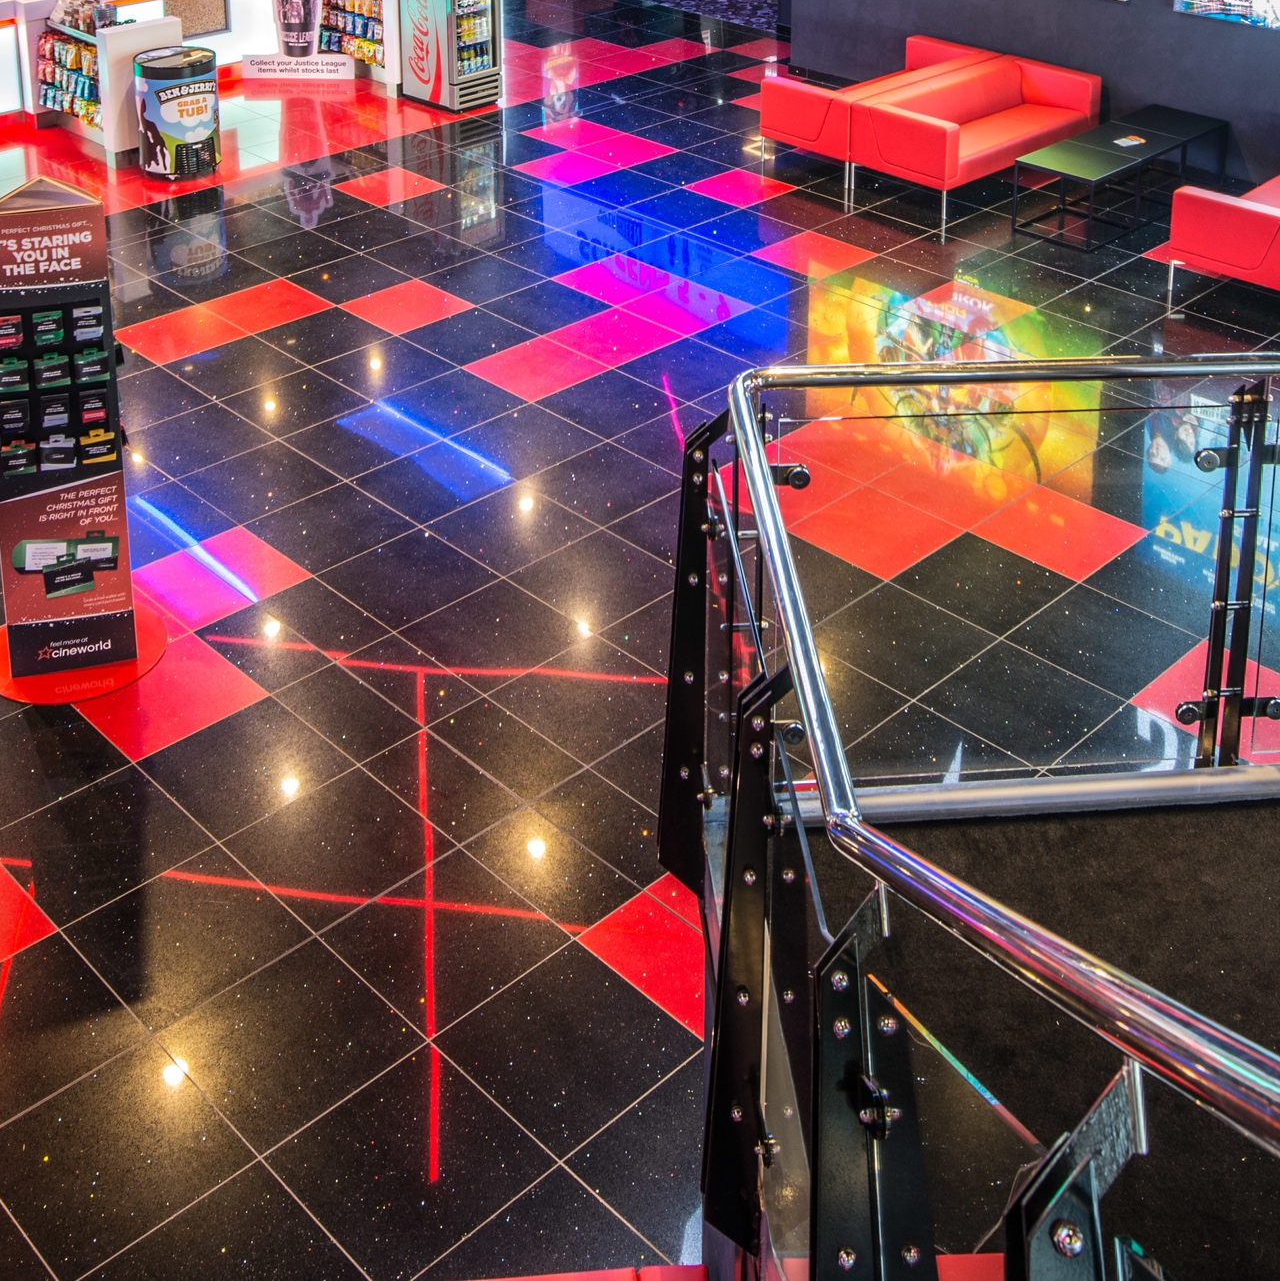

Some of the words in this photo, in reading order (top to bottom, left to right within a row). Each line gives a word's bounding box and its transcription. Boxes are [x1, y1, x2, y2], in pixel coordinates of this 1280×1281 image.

[249, 59, 275, 67] Collect
[293, 59, 319, 67] Justice
[320, 59, 347, 69] League
[158, 87, 181, 102] BEN
[180, 85, 190, 95] &
[177, 98, 201, 108] GRAB
[201, 96, 207, 104] A
[177, 104, 208, 119] TUB!
[1, 227, 31, 235] PERFECT
[32, 222, 71, 232] CHRISTMAS
[21, 231, 93, 250] STARING
[12, 249, 48, 263] YOU
[51, 246, 70, 260] IN
[2, 263, 36, 277] THE
[39, 257, 82, 274] FACE
[59, 492, 77, 501] THE
[78, 485, 118, 498] PERFECT
[46, 499, 96, 512] CHRISTMAS
[97, 494, 118, 504] GIFT
[48, 510, 75, 521] RIGHT
[88, 503, 119, 515] FRONT
[79, 517, 94, 526] OF
[49, 640, 62, 648] feel
[51, 639, 112, 659] cineworld
